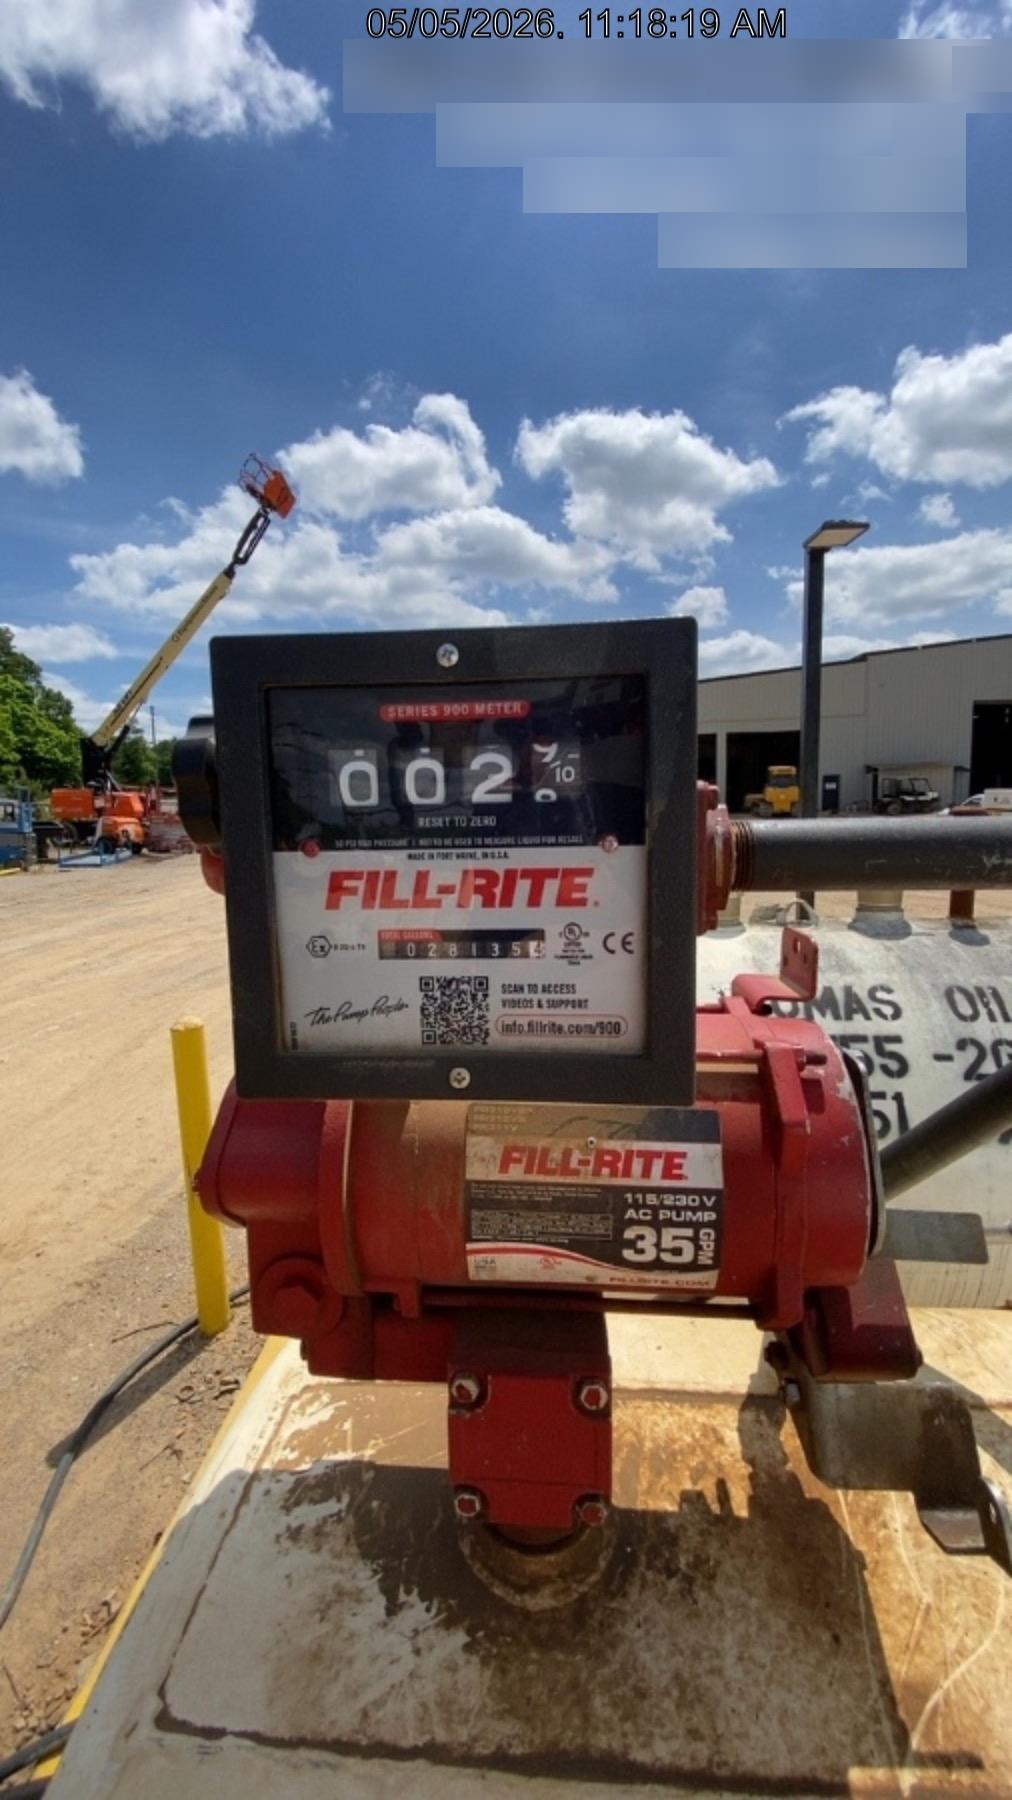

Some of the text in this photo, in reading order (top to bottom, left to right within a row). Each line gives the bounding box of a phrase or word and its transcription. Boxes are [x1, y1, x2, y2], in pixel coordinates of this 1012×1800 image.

[387, 701, 522, 718] SERIES 900 METER
[418, 815, 497, 828] RESET TO ZERO
[324, 868, 595, 910] FILL-RITE
[602, 931, 635, 955] CE
[501, 983, 577, 995] SCAN TO ACCESS
[501, 998, 535, 1009] VIDEOS
[546, 998, 589, 1009] SUPPORT
[501, 1020, 621, 1035] info.fillrite.com/900
[498, 1144, 687, 1181] FILL-RITE
[623, 1209, 717, 1223] AC PUMP
[621, 1225, 696, 1264] 35
[697, 1228, 716, 1265] GPM
